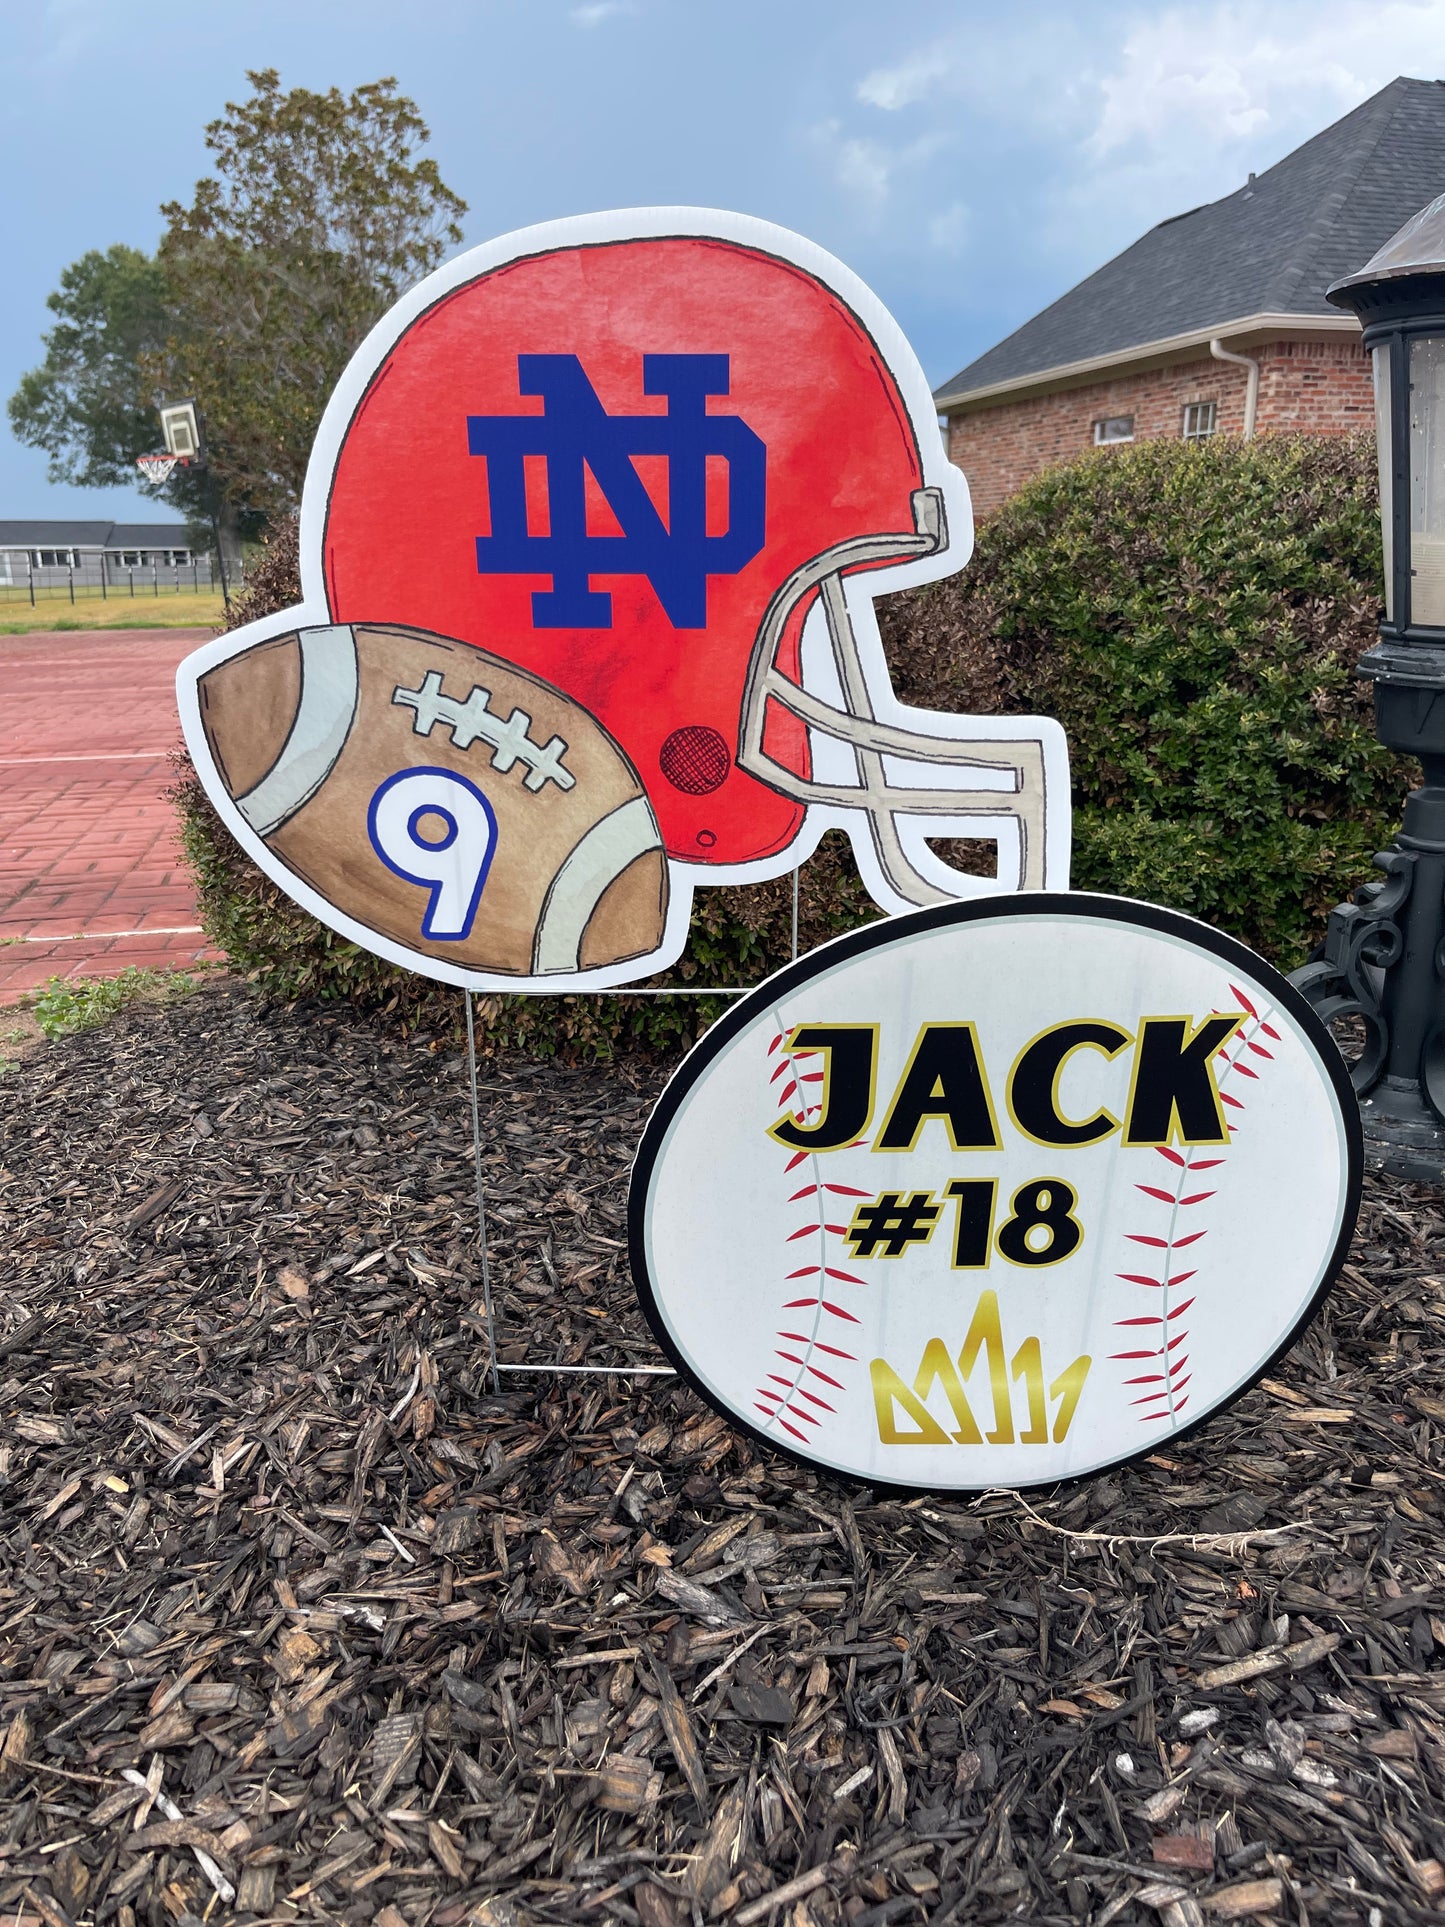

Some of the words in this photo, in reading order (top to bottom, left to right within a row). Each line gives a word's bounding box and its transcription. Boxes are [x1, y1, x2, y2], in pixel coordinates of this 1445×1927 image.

[367, 766, 498, 940] 9
[765, 1012, 1253, 1153] JACK
[842, 1176, 1085, 1270] #18
